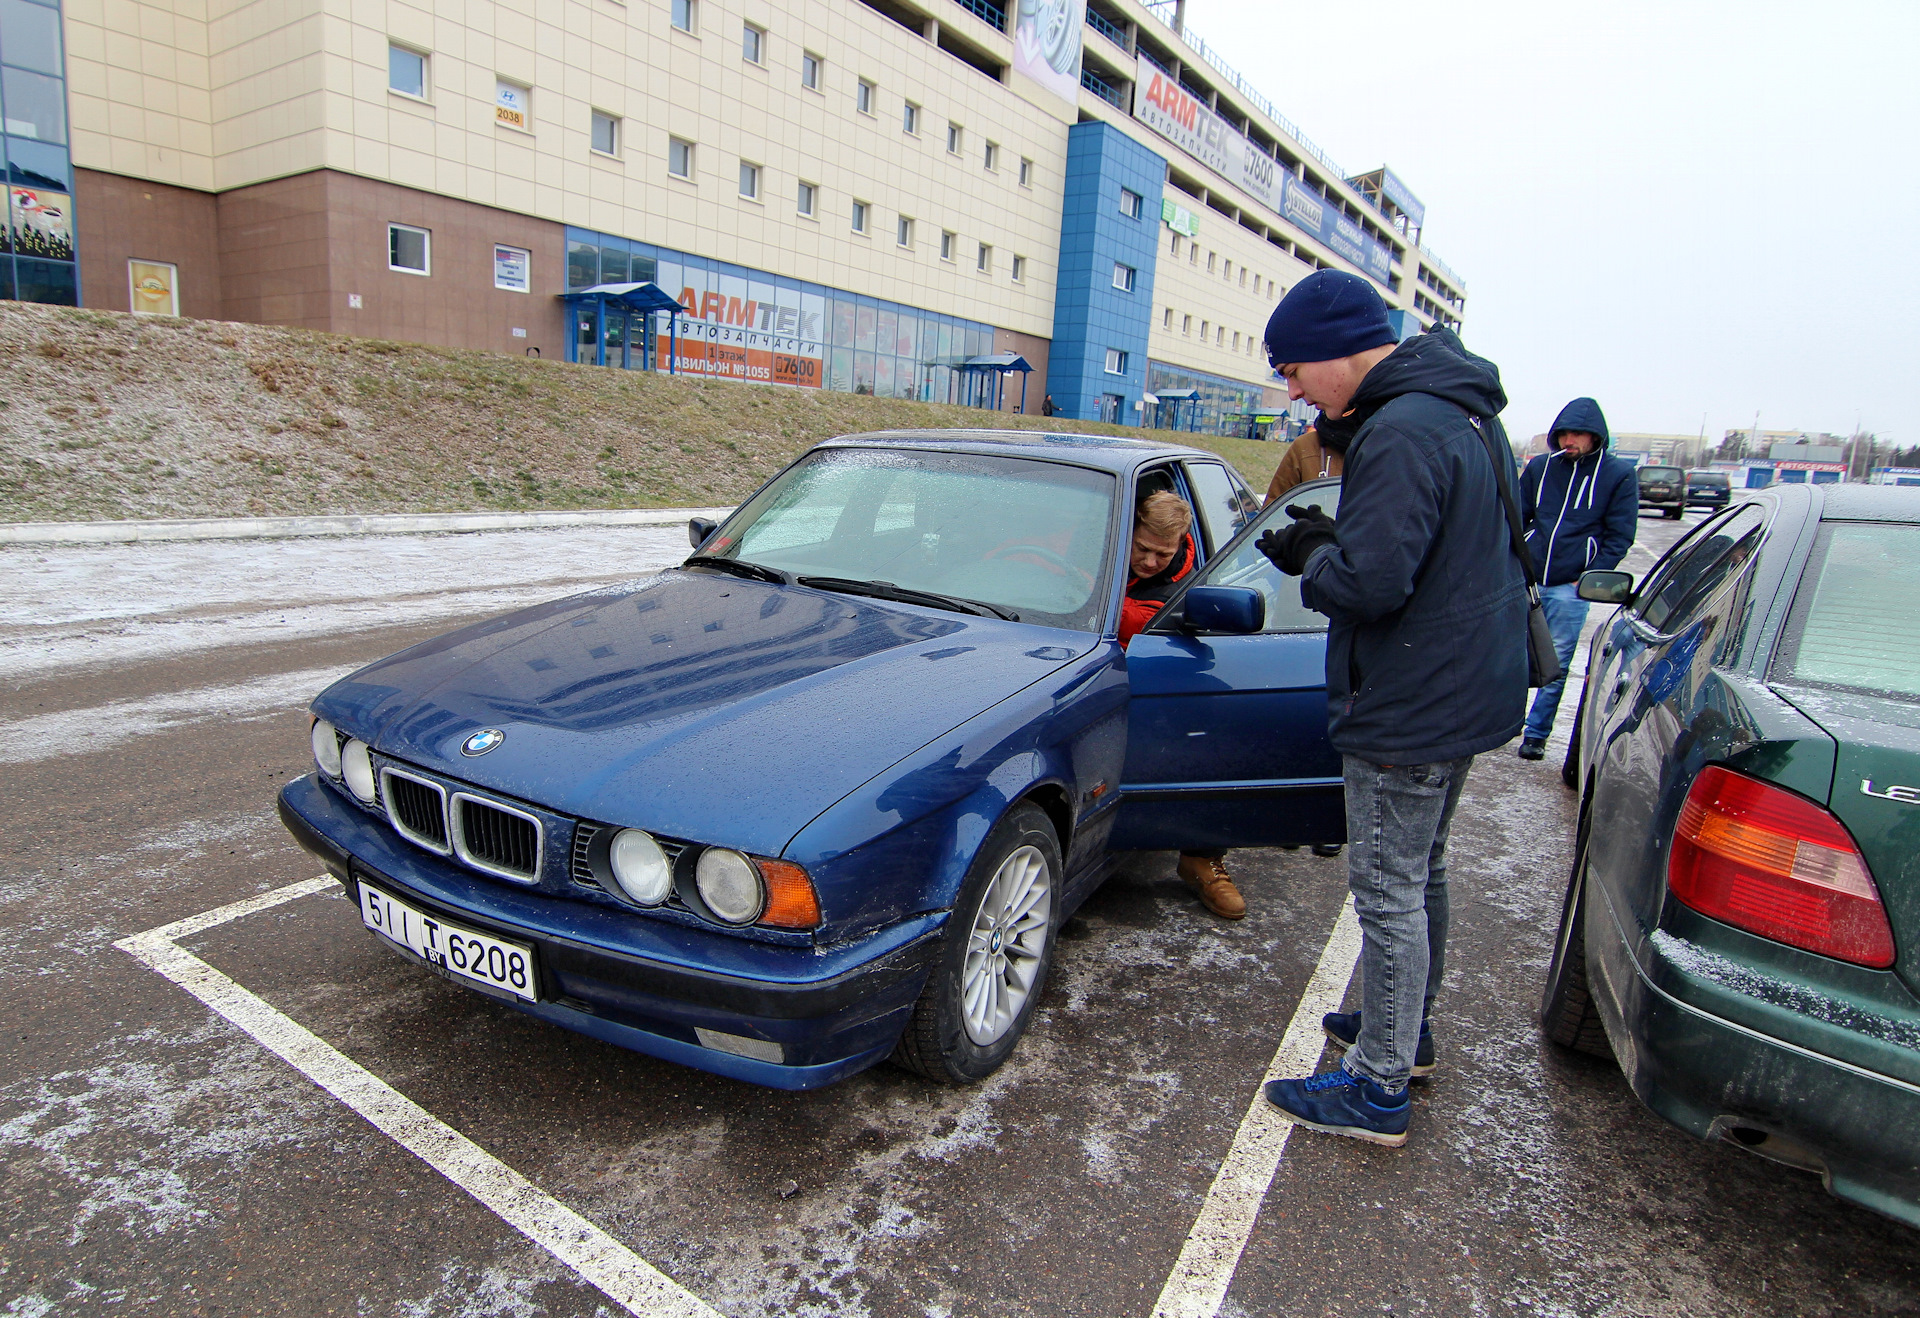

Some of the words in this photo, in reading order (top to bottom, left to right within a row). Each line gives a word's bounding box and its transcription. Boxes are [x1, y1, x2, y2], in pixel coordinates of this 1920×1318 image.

[497, 107, 520, 123] 2038
[1146, 72, 1232, 158] ARMTEK
[1141, 106, 1227, 173] АВТОЗАПЧАСТИ
[1250, 149, 1274, 189] 7600
[1293, 195, 1322, 223] STELLOX
[674, 286, 820, 340] ARMTEK
[666, 320, 816, 354] АВТОЗАПЧАСТИ
[709, 347, 715, 358] 1
[719, 350, 746, 362] этаж
[783, 357, 815, 378] 7600
[1778, 461, 1845, 472] АВТОСЕРВИС
[428, 949, 441, 965] BY
